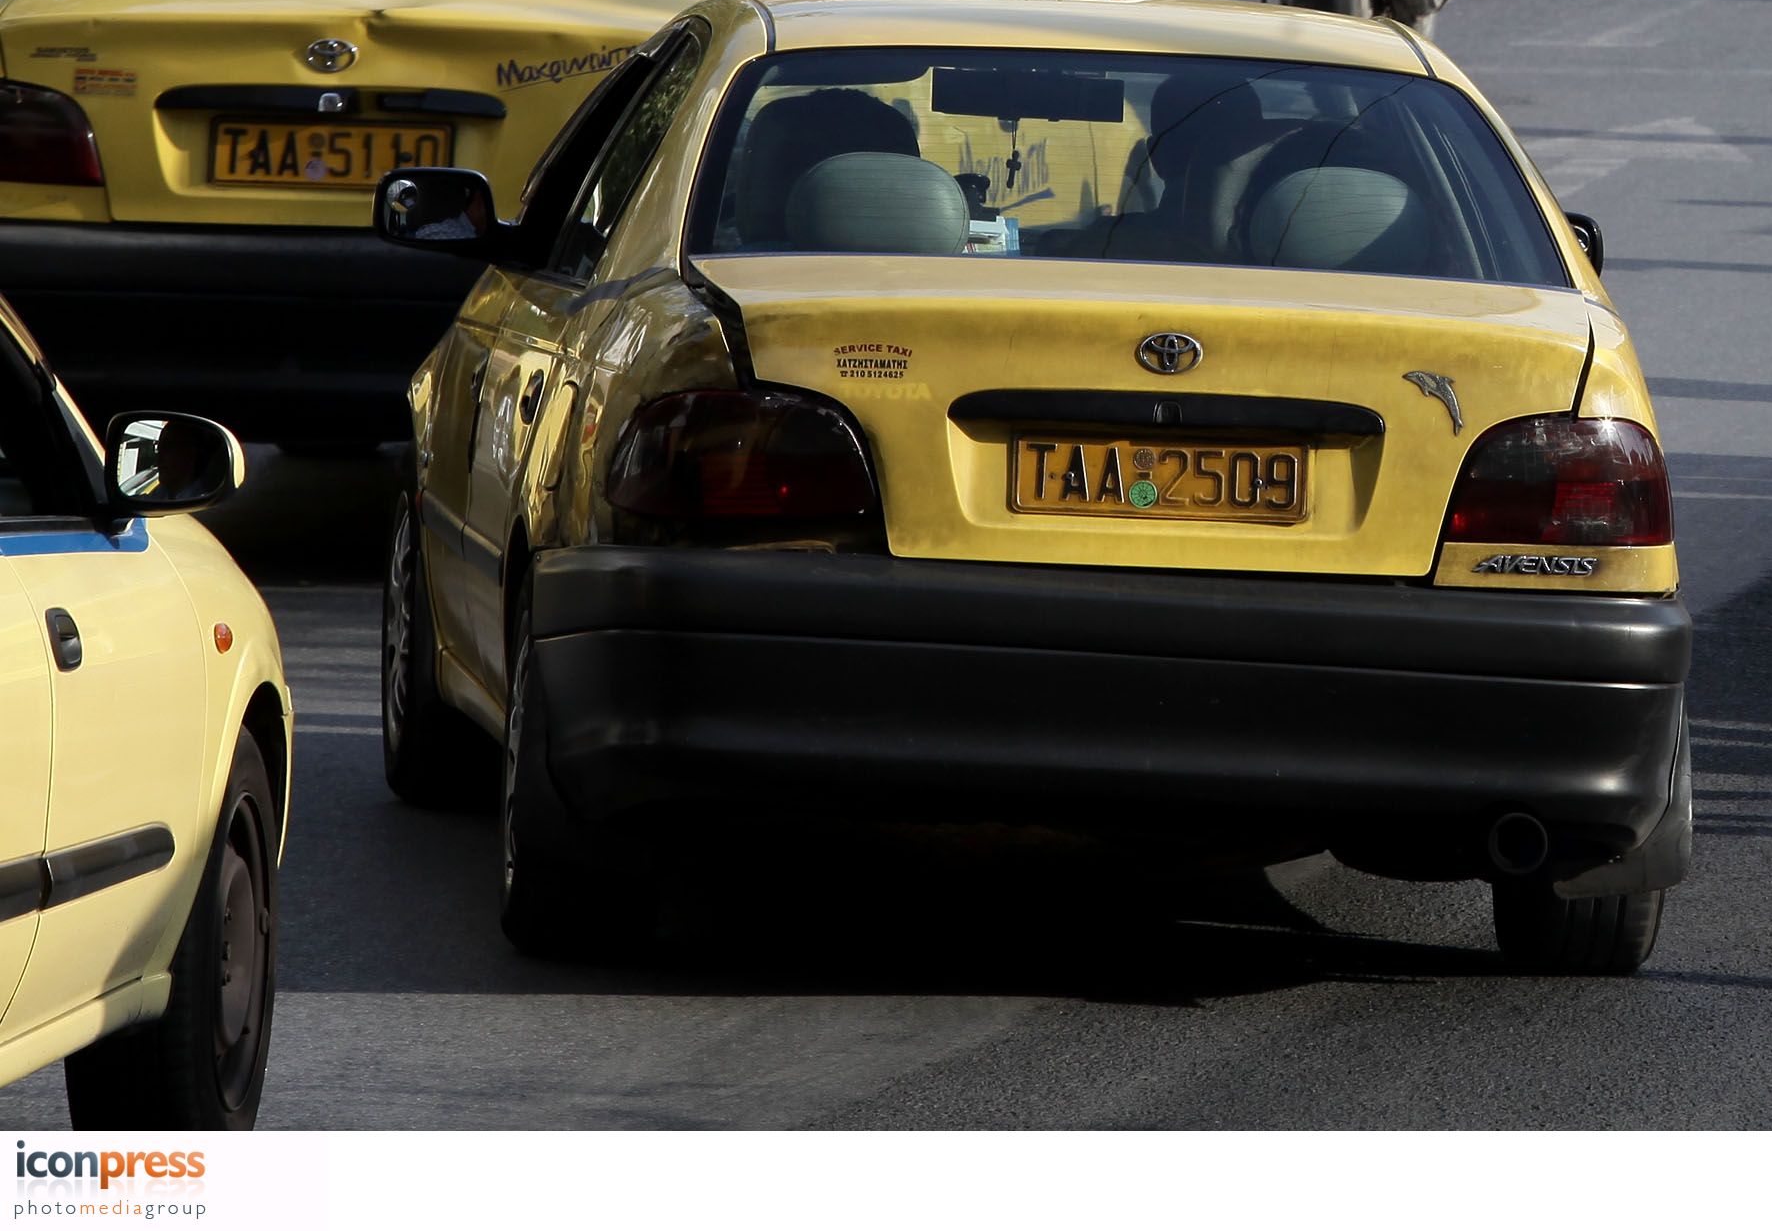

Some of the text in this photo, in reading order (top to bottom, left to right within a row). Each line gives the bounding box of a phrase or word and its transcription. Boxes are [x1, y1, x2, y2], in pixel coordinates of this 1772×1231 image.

[834, 343, 913, 358] SERVICE TAXI
[836, 358, 908, 370] ΧΑΤΖΗΣΤΑΜΑΤΗΣ
[850, 370, 866, 378] 210
[1471, 553, 1598, 577] AVENSIS
